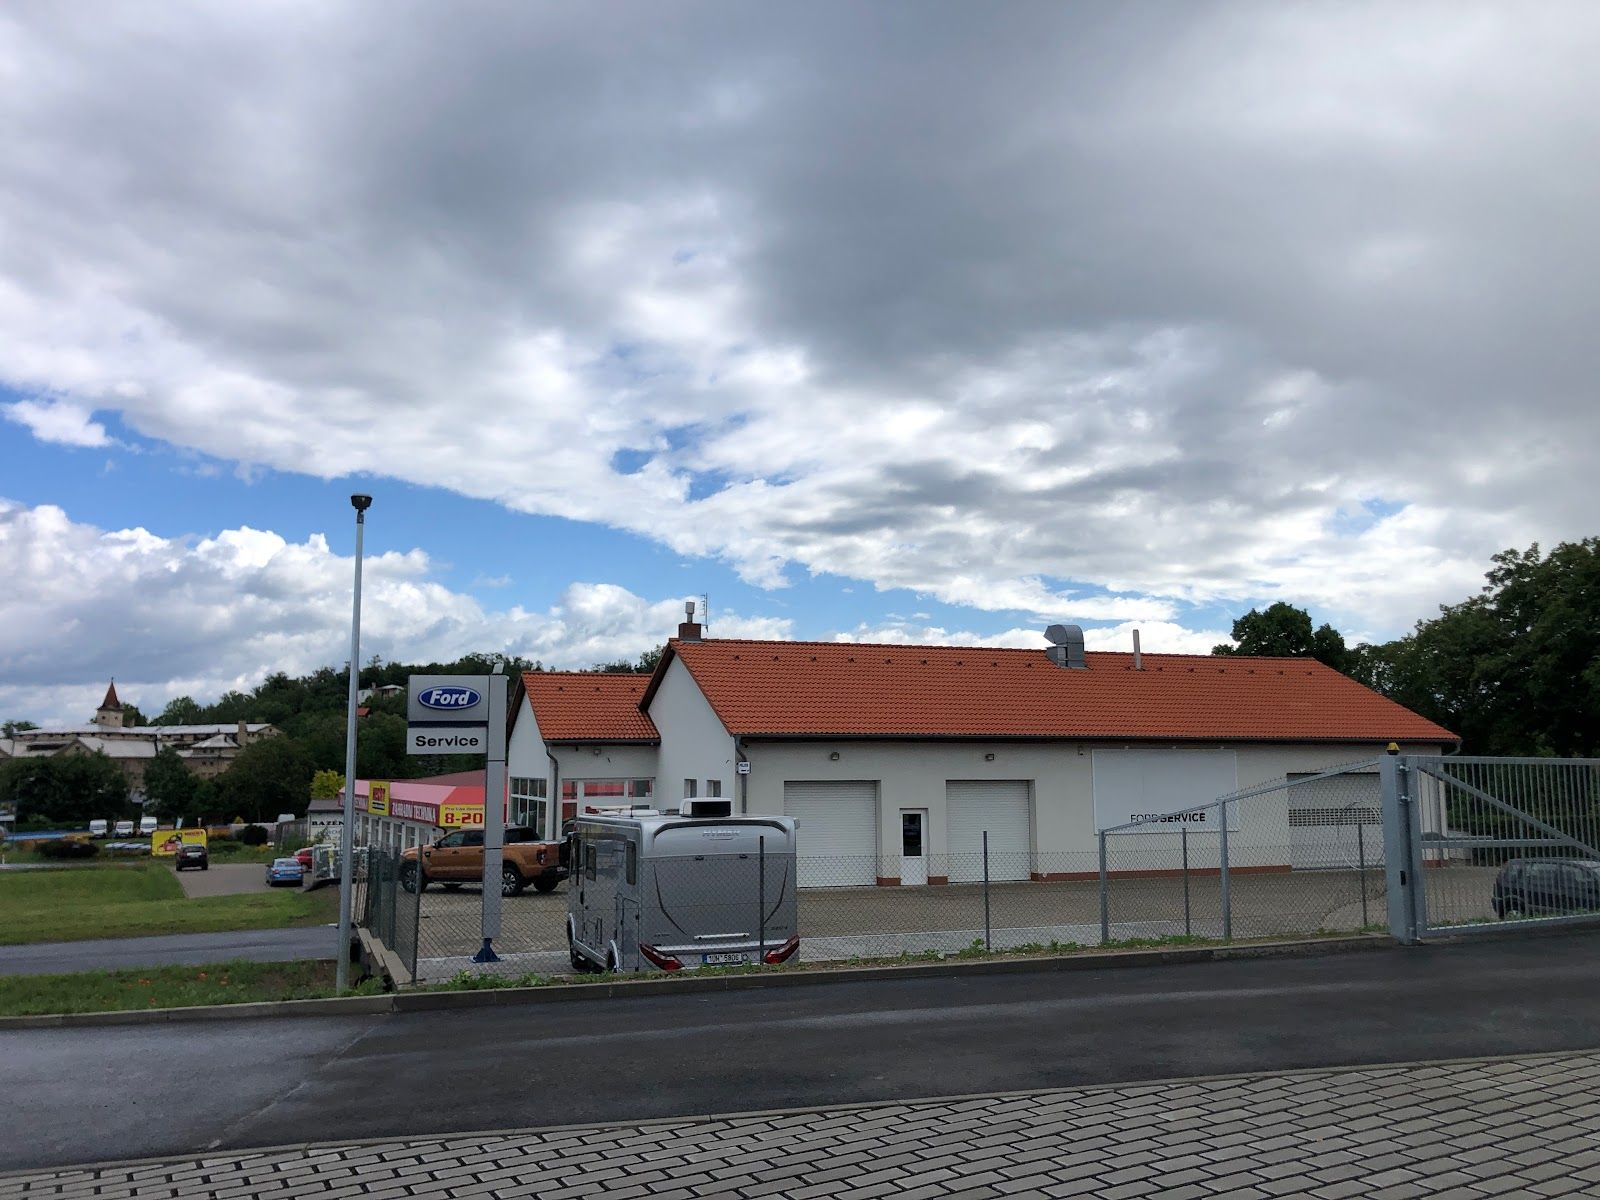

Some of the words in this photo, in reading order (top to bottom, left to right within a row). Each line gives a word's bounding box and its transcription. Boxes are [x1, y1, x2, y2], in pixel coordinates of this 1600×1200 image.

[429, 690, 471, 705] Ford
[415, 735, 479, 747] Service
[445, 812, 483, 824] 8-20
